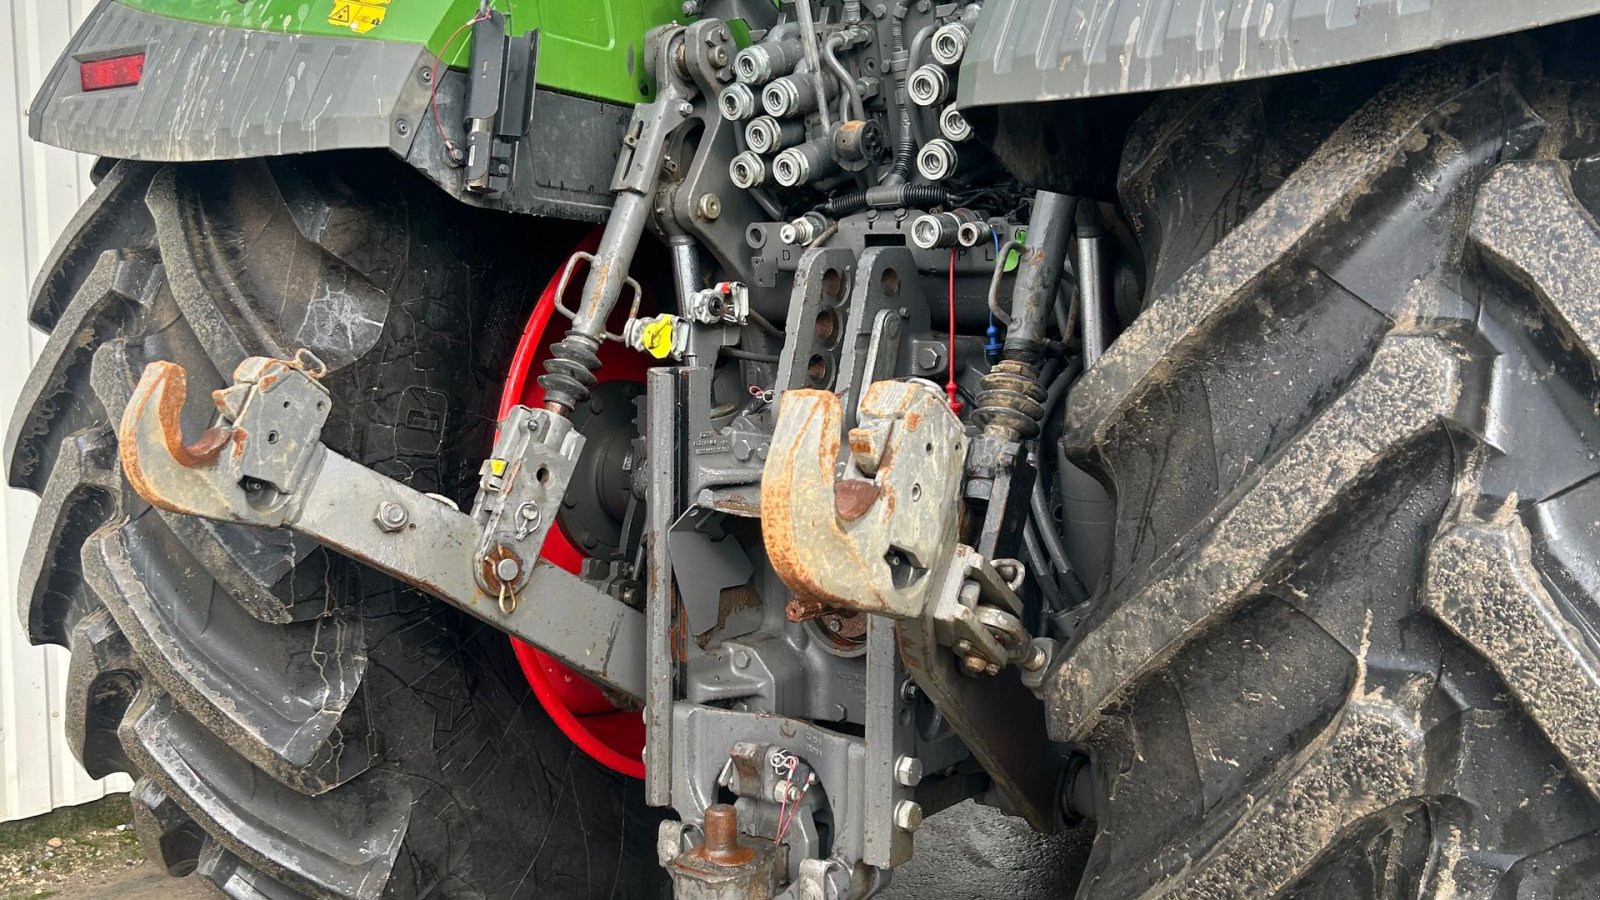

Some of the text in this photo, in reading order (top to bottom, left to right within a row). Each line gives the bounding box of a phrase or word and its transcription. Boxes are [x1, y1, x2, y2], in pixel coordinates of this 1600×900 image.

[782, 249, 791, 261] D
[958, 248, 967, 261] P
[985, 247, 994, 261] L
